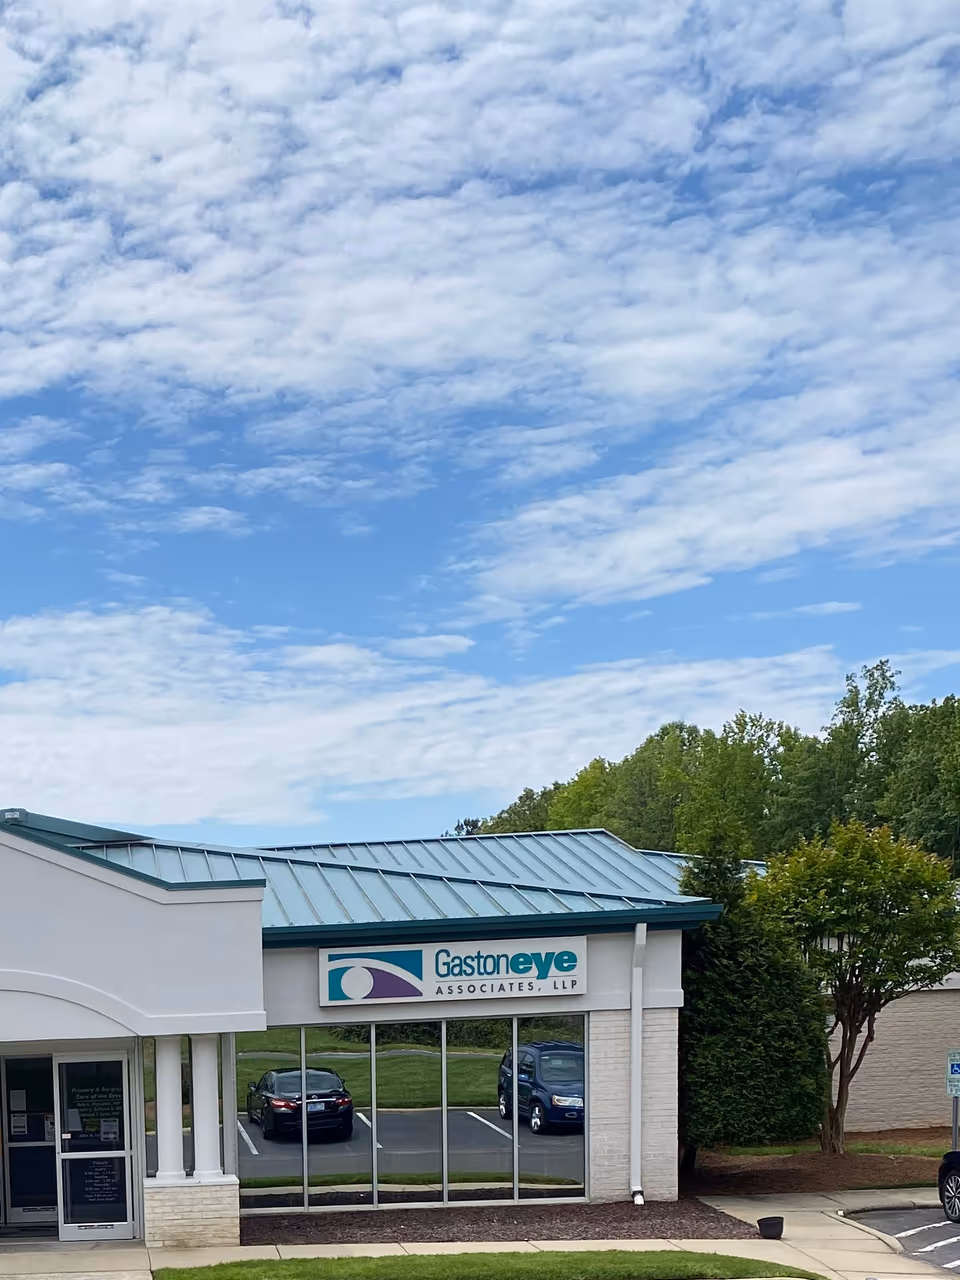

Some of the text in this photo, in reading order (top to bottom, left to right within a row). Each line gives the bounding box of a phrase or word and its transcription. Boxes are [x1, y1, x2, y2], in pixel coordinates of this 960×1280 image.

[435, 949, 578, 980] Gastoneye
[435, 980, 577, 995] ASSOCIATES, LLP
